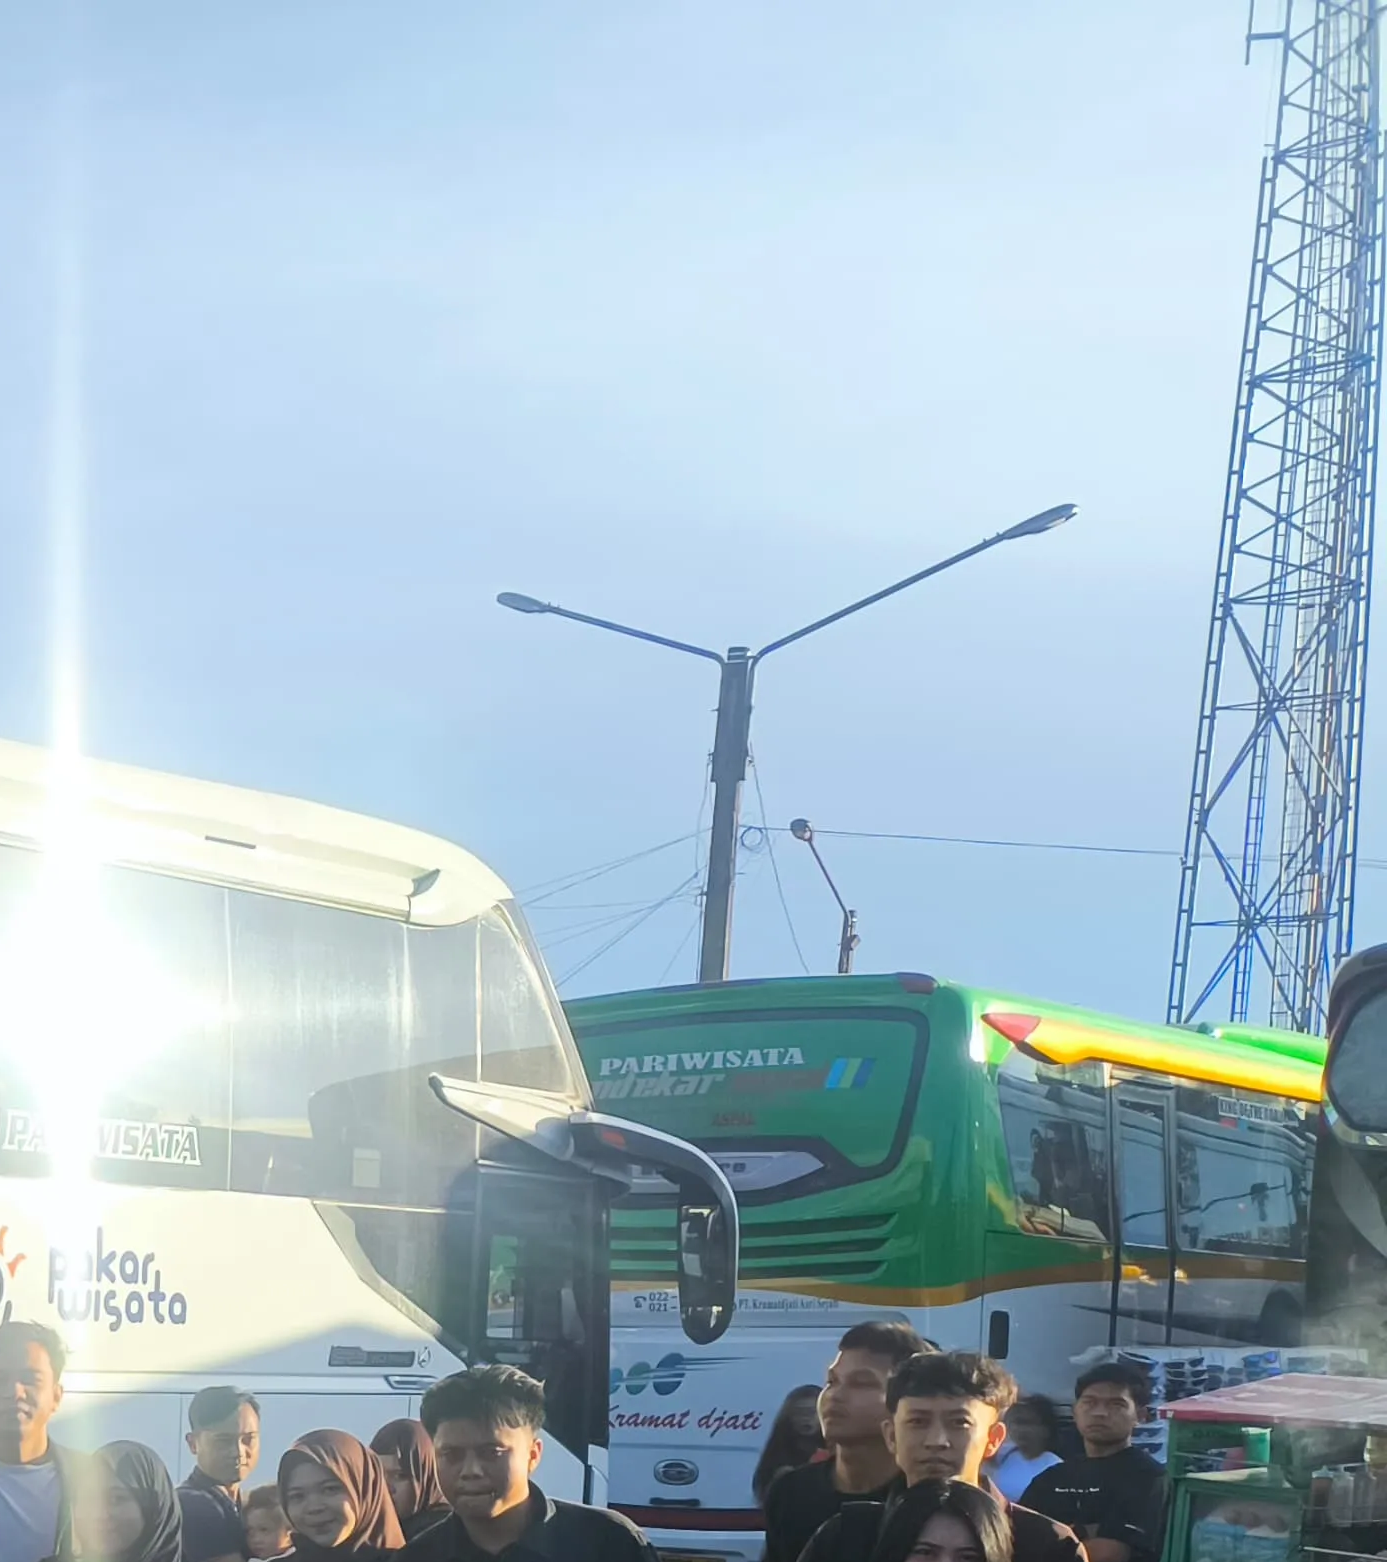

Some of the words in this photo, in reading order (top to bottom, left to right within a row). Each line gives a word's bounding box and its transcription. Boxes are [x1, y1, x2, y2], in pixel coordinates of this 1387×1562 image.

[599, 1047, 804, 1076] PARIWISATA
[3, 1109, 202, 1165] PAISATA
[57, 1270, 187, 1331] wisata
[697, 1407, 763, 1438] djati
